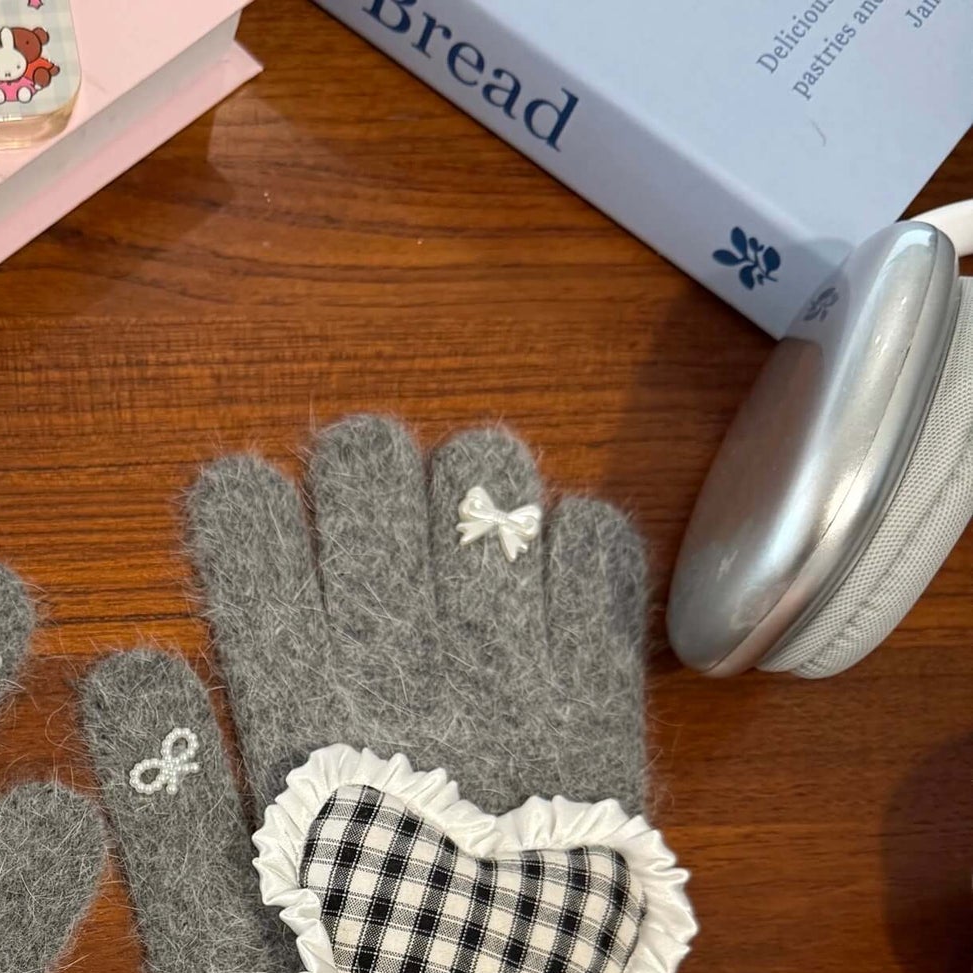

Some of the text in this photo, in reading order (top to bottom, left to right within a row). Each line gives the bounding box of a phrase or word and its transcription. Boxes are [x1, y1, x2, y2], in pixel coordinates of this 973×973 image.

[362, 0, 579, 152] Bread
[792, 0, 884, 100] pastries an
